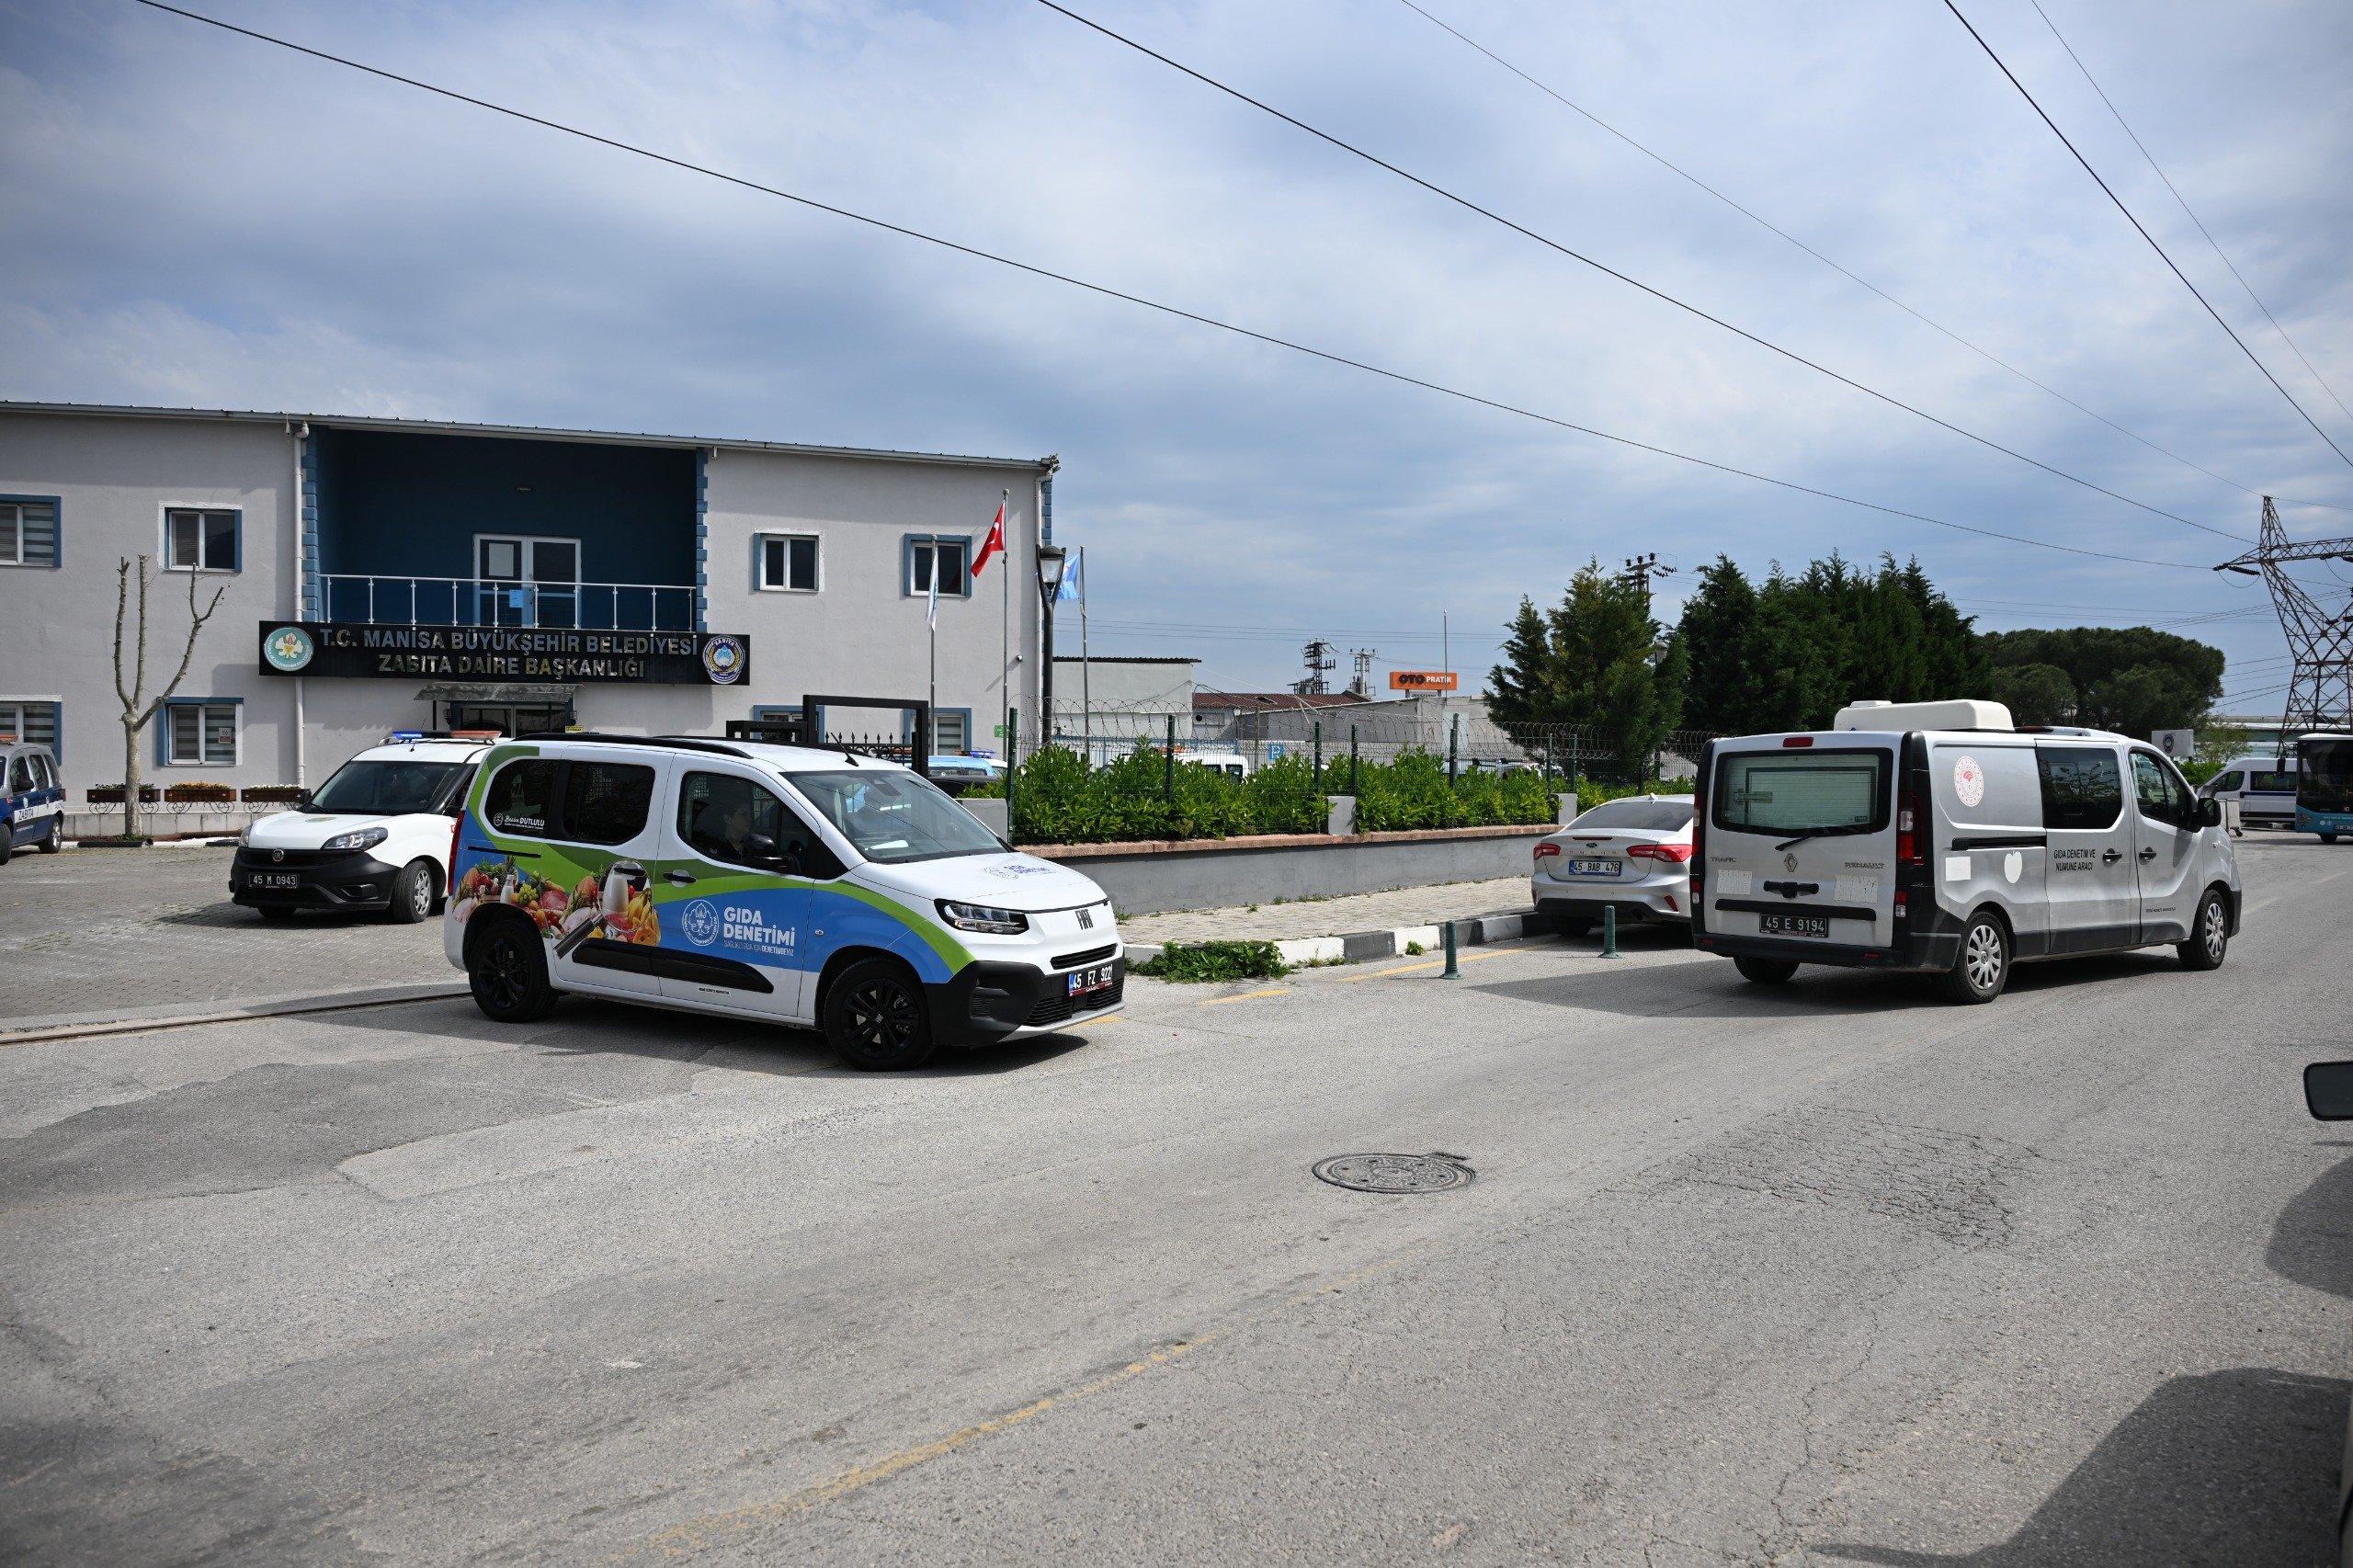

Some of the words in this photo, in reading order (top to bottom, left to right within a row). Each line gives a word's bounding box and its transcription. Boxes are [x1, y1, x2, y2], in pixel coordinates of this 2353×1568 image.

[319, 628, 358, 647] T.C.
[363, 627, 446, 650] MANİSA
[451, 629, 580, 656] BÜYÜKŞEHİR
[586, 633, 699, 655] BELEDİYESİ
[378, 653, 453, 673] ZABITA
[459, 653, 519, 675] DAİRE
[526, 656, 644, 680] BAŞKANLIĞI
[1398, 674, 1425, 685] OTO
[18, 808, 34, 821] ZABITA
[519, 817, 545, 827] DUTLULU
[2053, 849, 2066, 858] GIDA
[2089, 848, 2097, 858] VE
[1574, 862, 1583, 871] 45
[1587, 862, 1601, 872] BAB
[1605, 862, 1619, 872] 476
[253, 875, 263, 884] 45
[276, 876, 296, 885] 0943
[723, 906, 763, 926] GIDA
[1766, 916, 1779, 929] 45
[1784, 918, 1791, 930] E
[1798, 919, 1824, 932] 9194
[723, 923, 796, 947] DENETİMİ
[1074, 972, 1083, 989] 45
[1087, 970, 1097, 986] FZ
